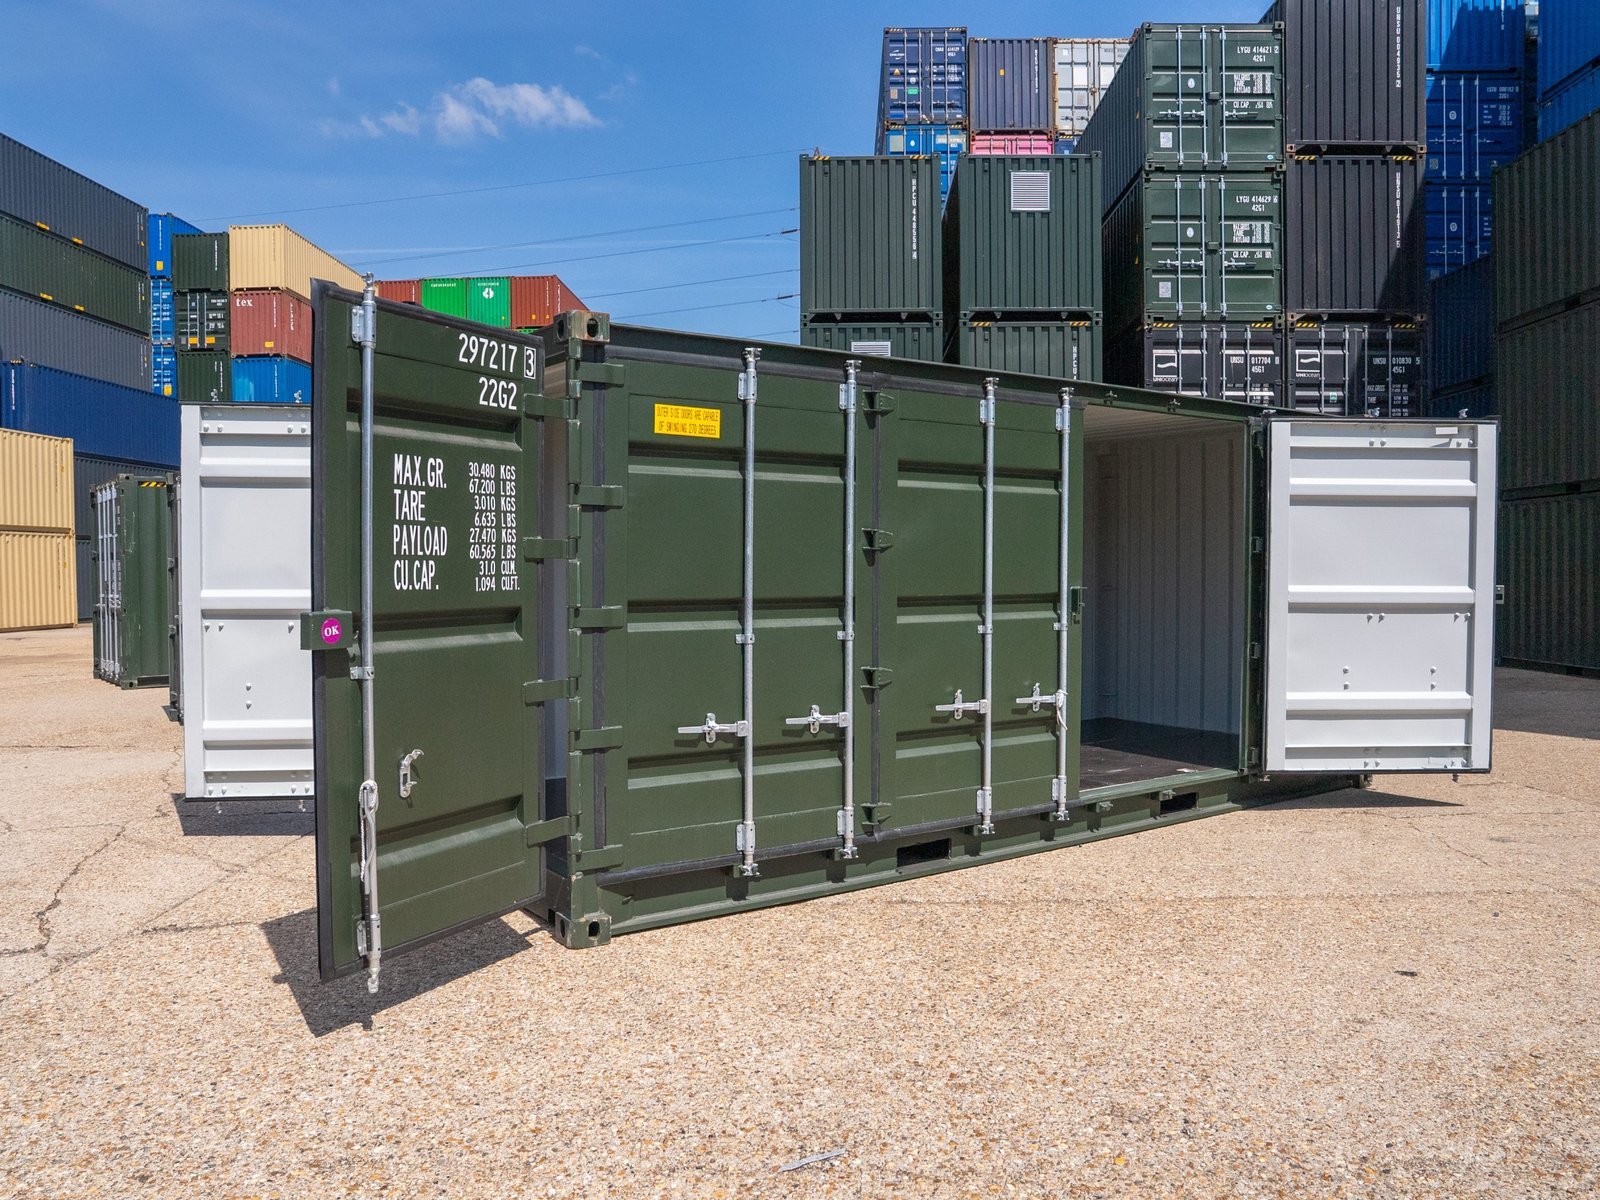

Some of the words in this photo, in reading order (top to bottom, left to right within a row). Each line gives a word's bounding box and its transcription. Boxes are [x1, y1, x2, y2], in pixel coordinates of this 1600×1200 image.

[236, 298, 252, 306] tex
[459, 333, 518, 373] 297217
[525, 348, 535, 378] 3
[479, 376, 517, 410] 22G2
[468, 462, 496, 478] 30.480
[500, 465, 516, 480] KGS
[469, 478, 496, 494] 67.200
[500, 480, 516, 496] LBS
[394, 488, 426, 521] TARE
[474, 495, 496, 510] 3.010
[500, 496, 516, 512] KGS
[474, 512, 496, 526] 6.635
[500, 512, 516, 528] LBS
[393, 524, 448, 556] PAYLOAD
[470, 528, 496, 543] 27.470
[501, 528, 517, 544] KGS
[470, 544, 496, 559] 60.565
[500, 544, 516, 559] LBS
[394, 560, 440, 590] CU.CAP.
[479, 560, 496, 575] 31.0
[475, 576, 496, 592] 1.094
[324, 624, 340, 637] OK
